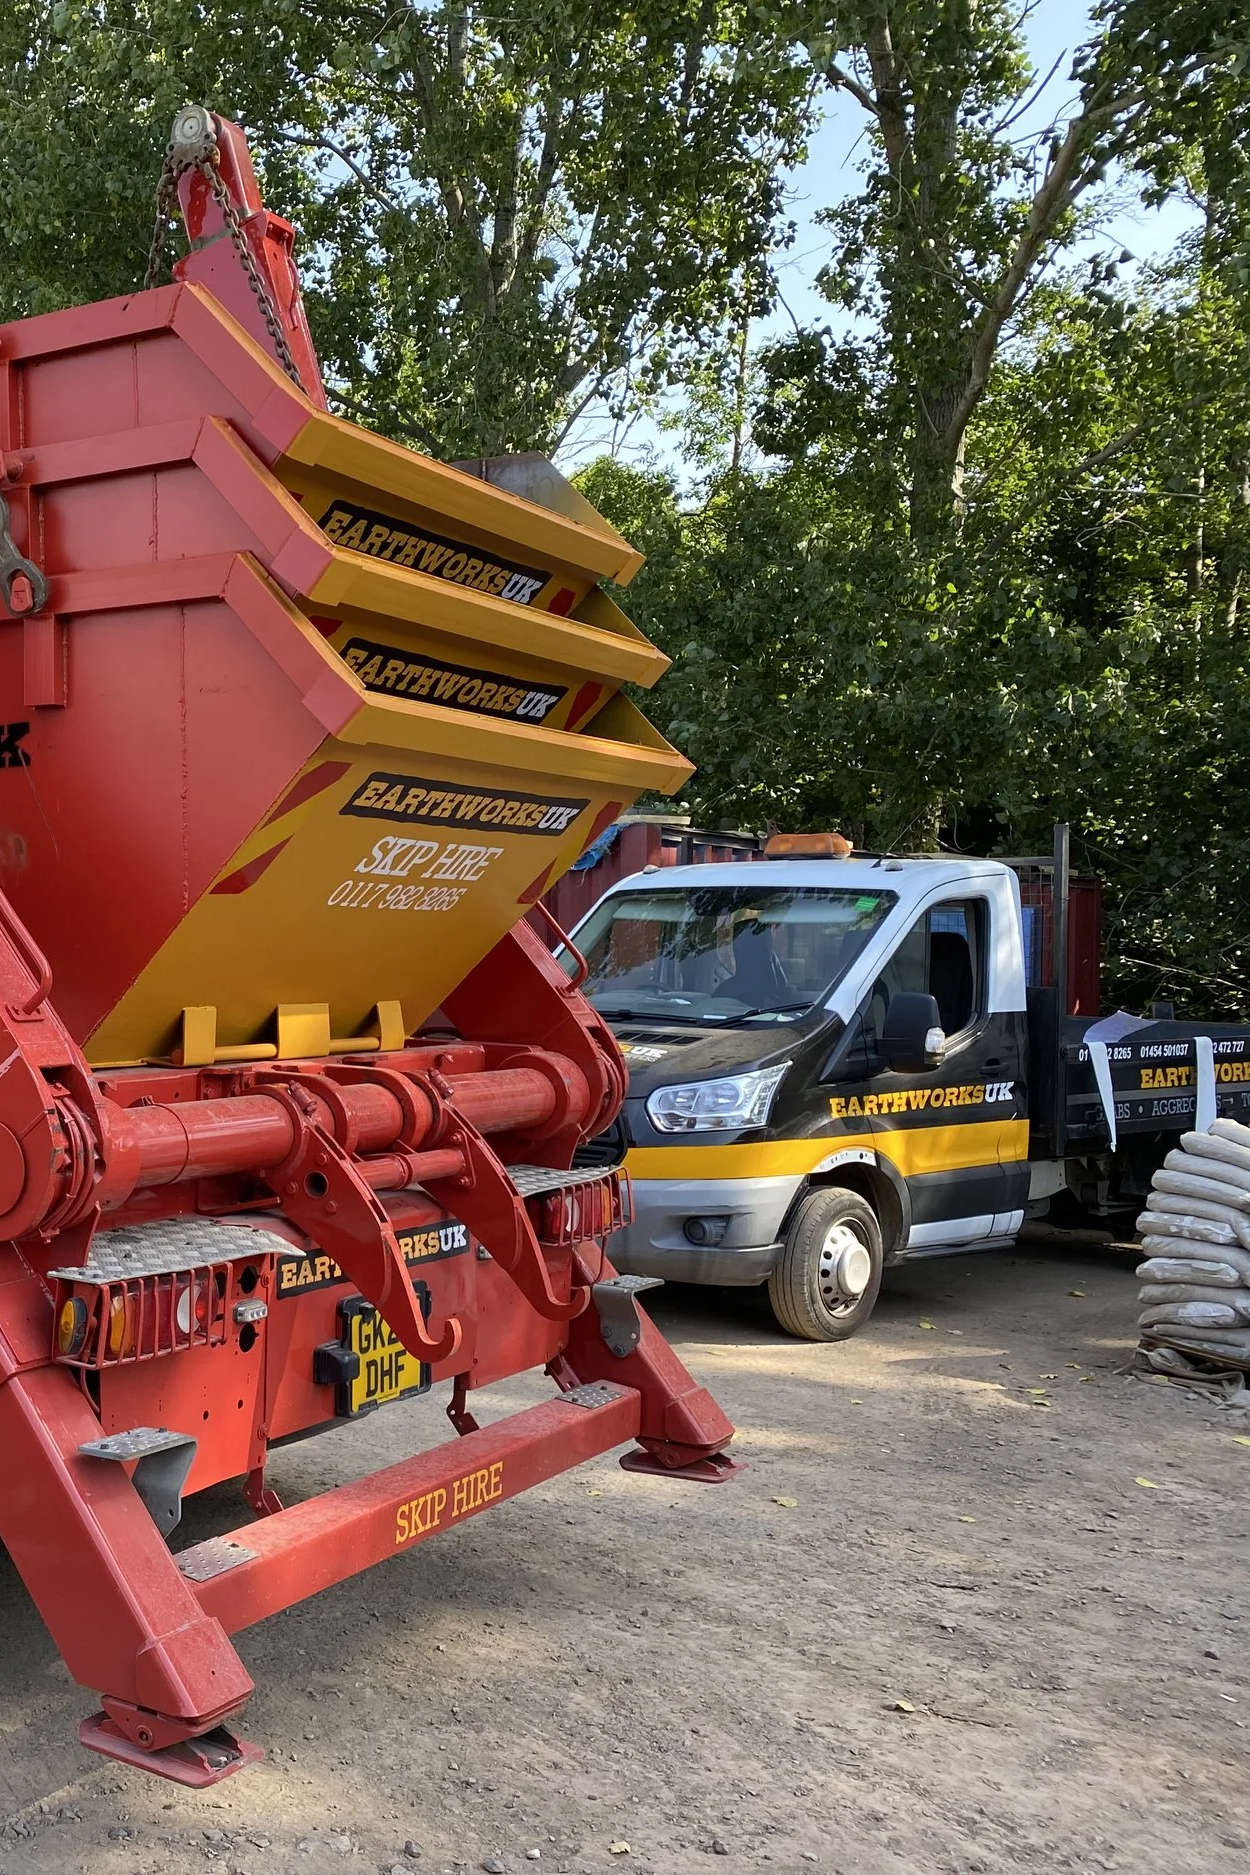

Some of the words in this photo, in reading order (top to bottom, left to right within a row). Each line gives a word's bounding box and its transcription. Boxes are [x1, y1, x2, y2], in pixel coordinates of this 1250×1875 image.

[322, 510, 543, 604] EARTHWORKSUK
[346, 648, 558, 718] EARTHWORKSUK
[352, 780, 579, 831] EARTHWORKSUK
[354, 835, 439, 877] SKIP
[421, 846, 504, 881] HIRE
[327, 880, 383, 908] 0117
[384, 884, 423, 910] 982
[414, 886, 467, 911] 8265
[1113, 1046, 1132, 1059] 8265
[1140, 1045, 1162, 1058] 01454
[1163, 1044, 1188, 1057] 501037
[1232, 1041, 1245, 1052] 727
[829, 1081, 1015, 1119] EARTHWORKSUK
[366, 1349, 407, 1398] DHF
[395, 1488, 447, 1544] SKIP
[451, 1461, 503, 1518] HIRE
